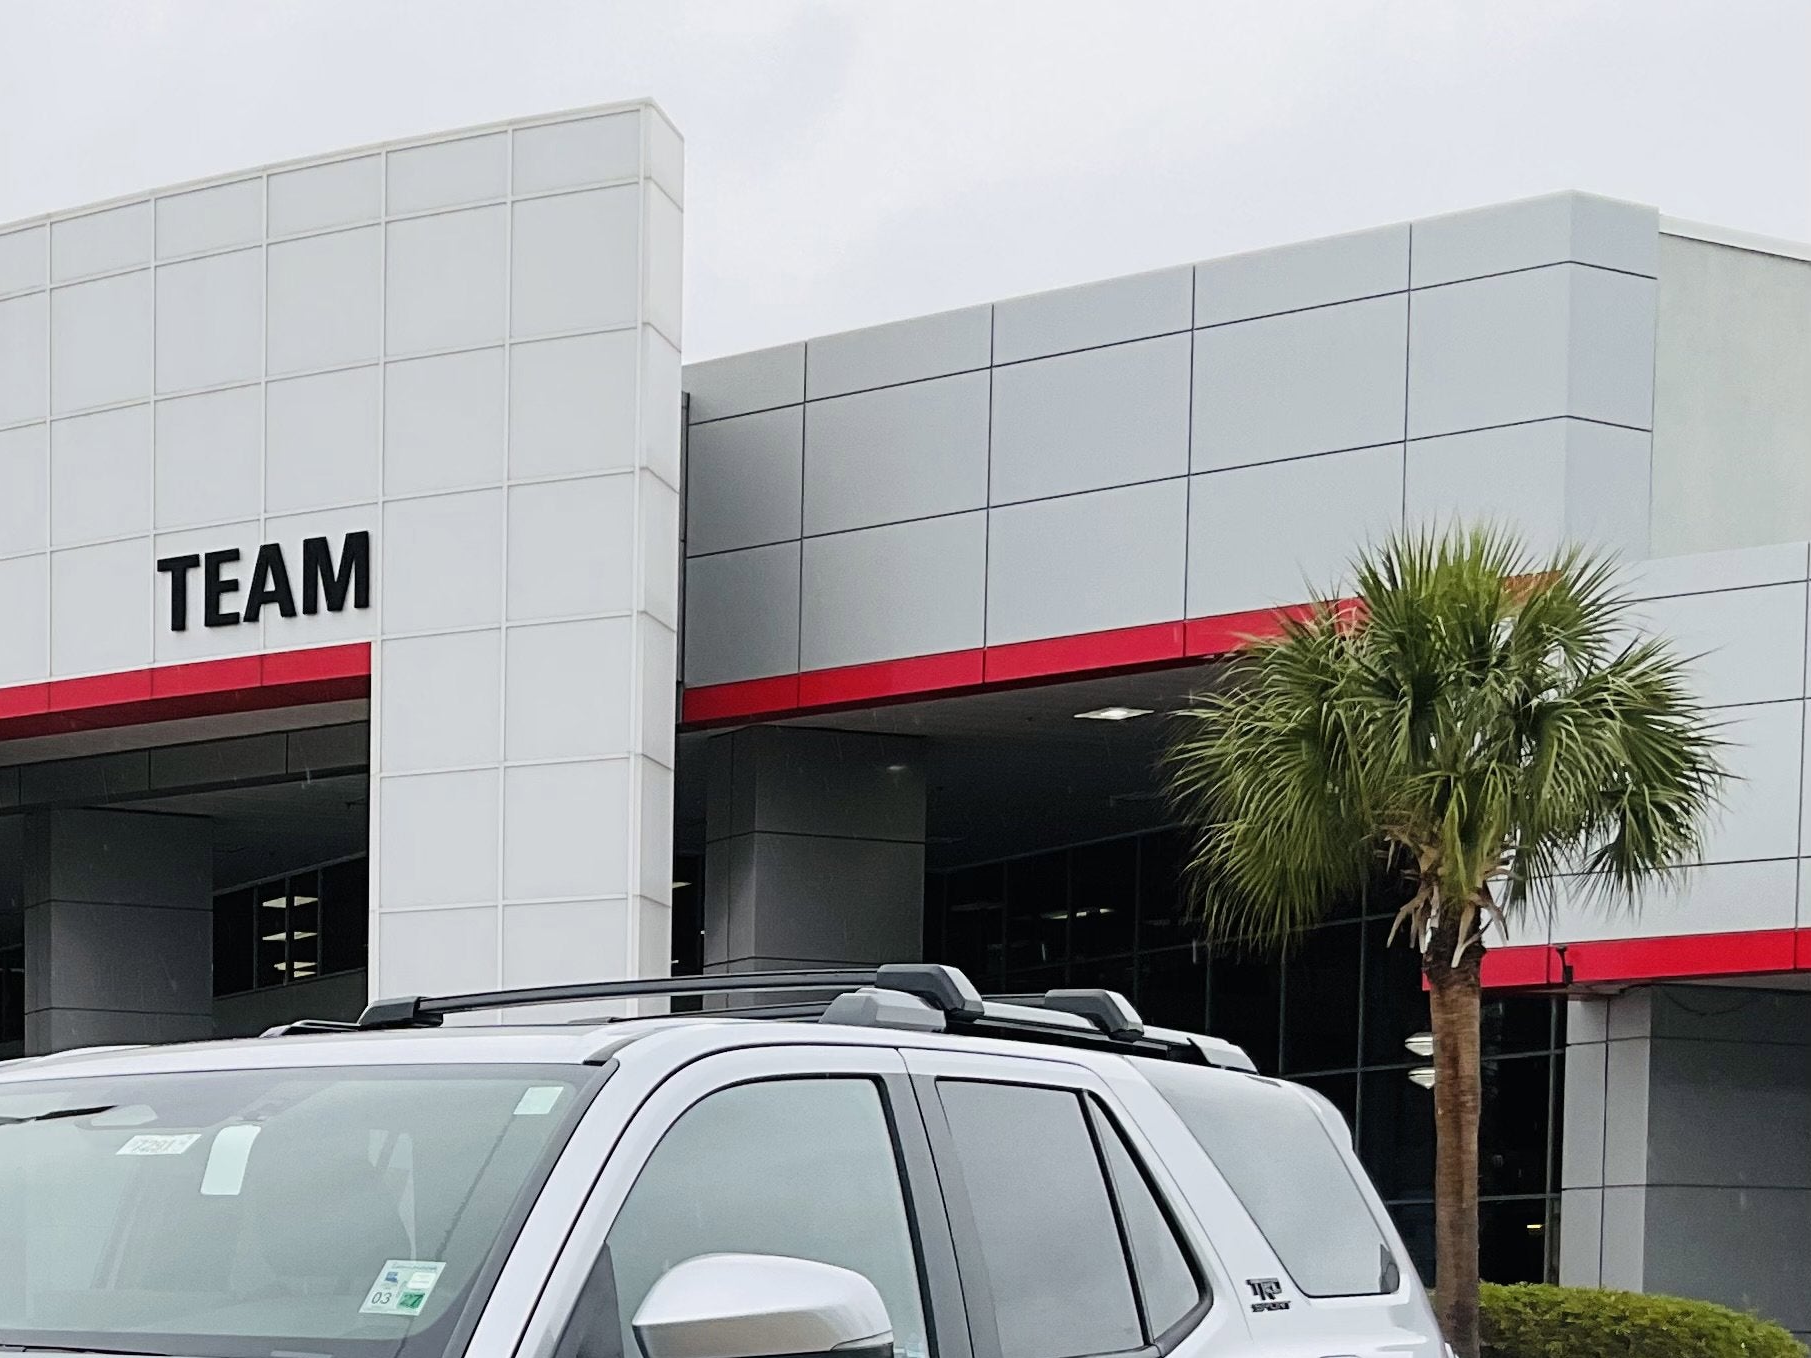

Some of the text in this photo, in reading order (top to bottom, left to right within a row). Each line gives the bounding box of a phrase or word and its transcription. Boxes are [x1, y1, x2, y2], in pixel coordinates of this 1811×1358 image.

[156, 530, 370, 632] TEAM
[371, 1291, 426, 1310] 03 27
